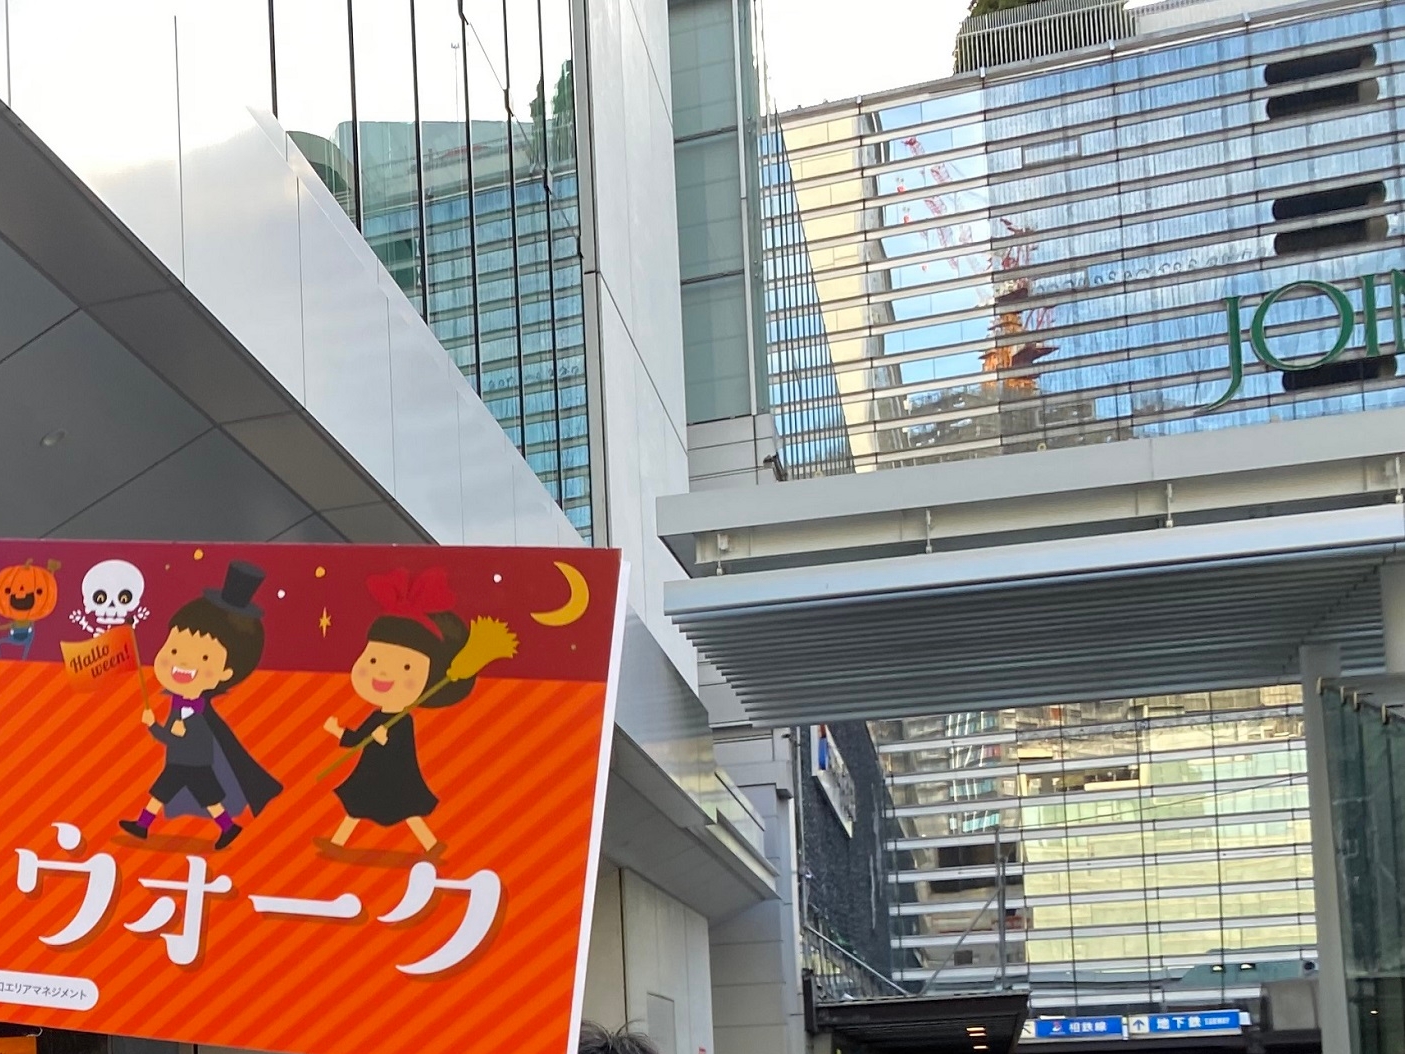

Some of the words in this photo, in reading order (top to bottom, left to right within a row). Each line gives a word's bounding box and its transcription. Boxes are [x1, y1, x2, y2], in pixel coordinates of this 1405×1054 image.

[1201, 268, 1405, 411] JOI
[70, 644, 110, 674] Hallo
[90, 642, 131, 679] ween!
[1156, 1016, 1202, 1030] 地下鉄
